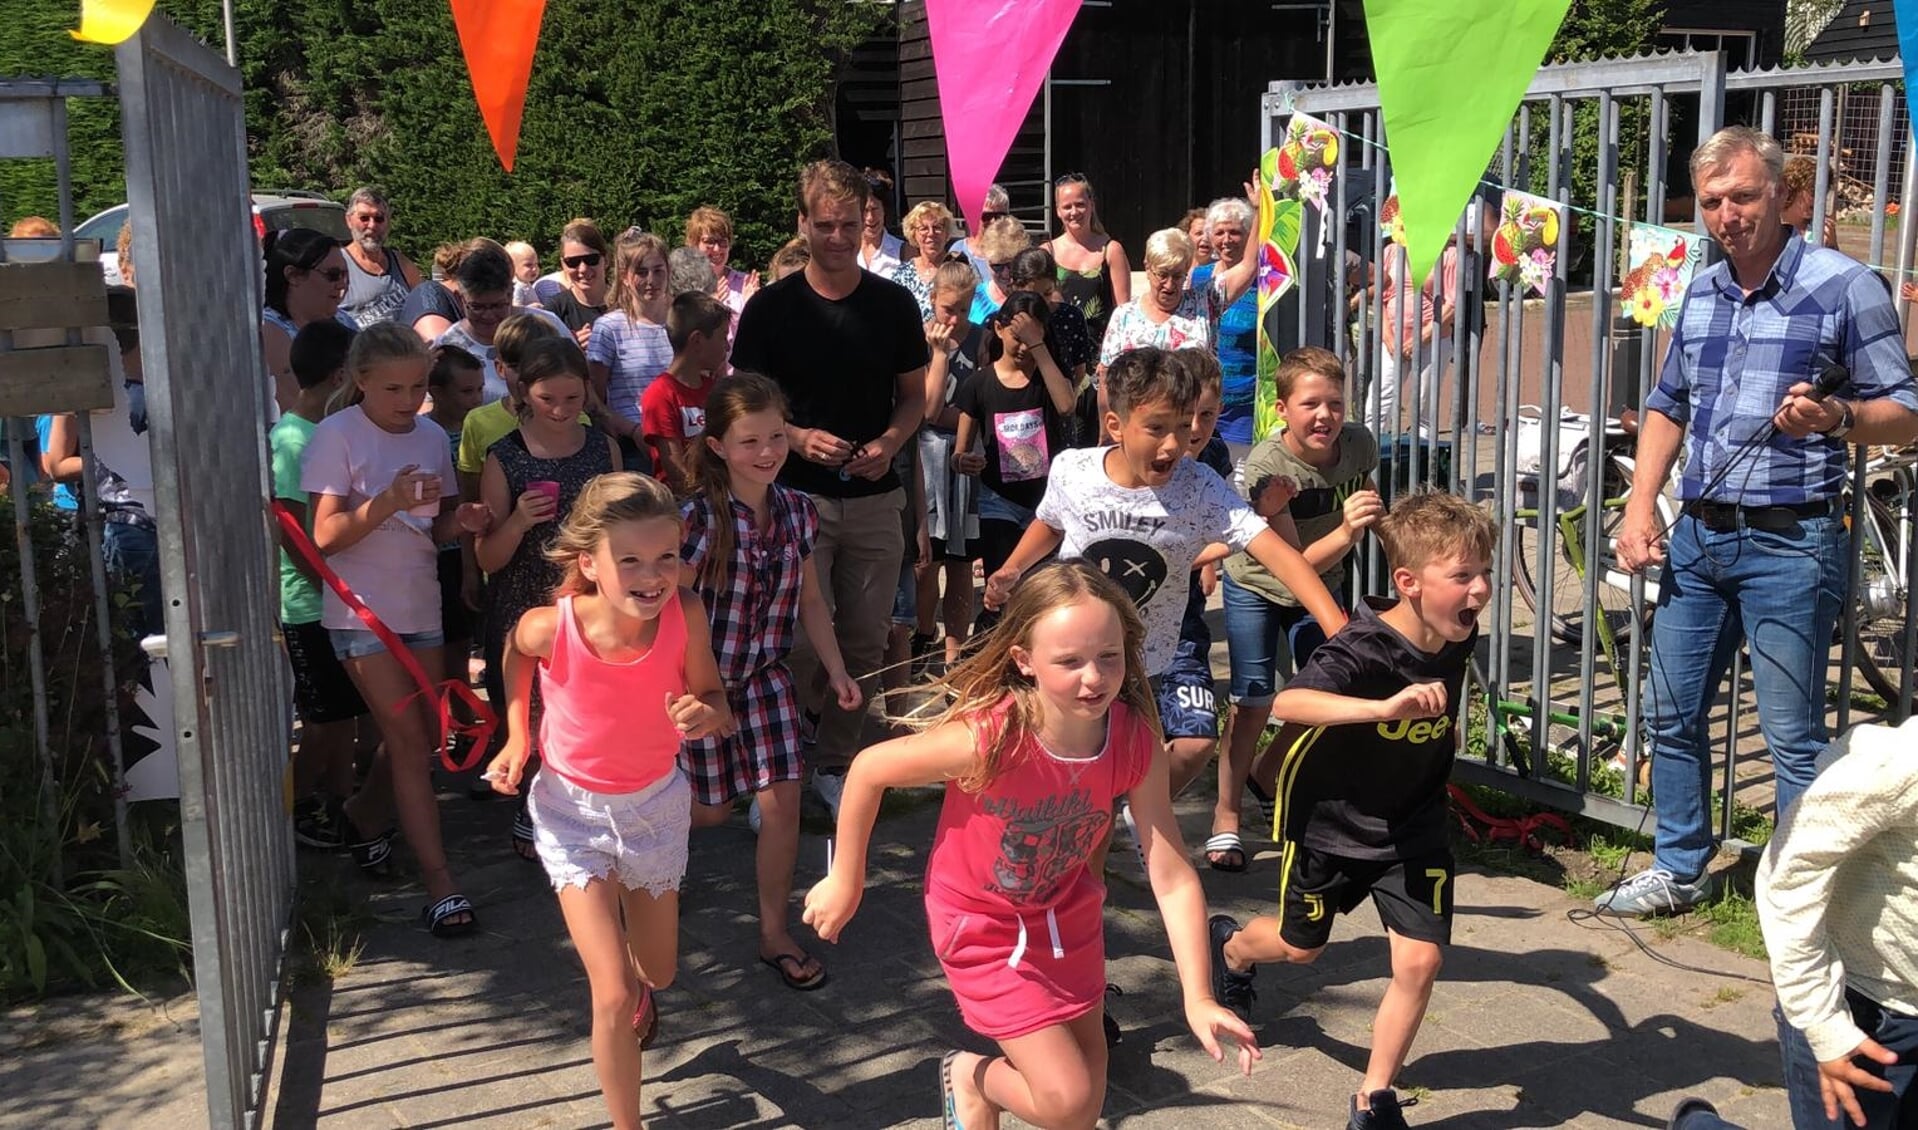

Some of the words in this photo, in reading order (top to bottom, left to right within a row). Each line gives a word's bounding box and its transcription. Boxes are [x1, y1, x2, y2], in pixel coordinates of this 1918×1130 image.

[1083, 510, 1166, 537] SMILEY
[1176, 685, 1215, 712] SUR
[1377, 715, 1452, 744] Jee
[1425, 868, 1447, 915] 7
[434, 899, 472, 919] FILA
